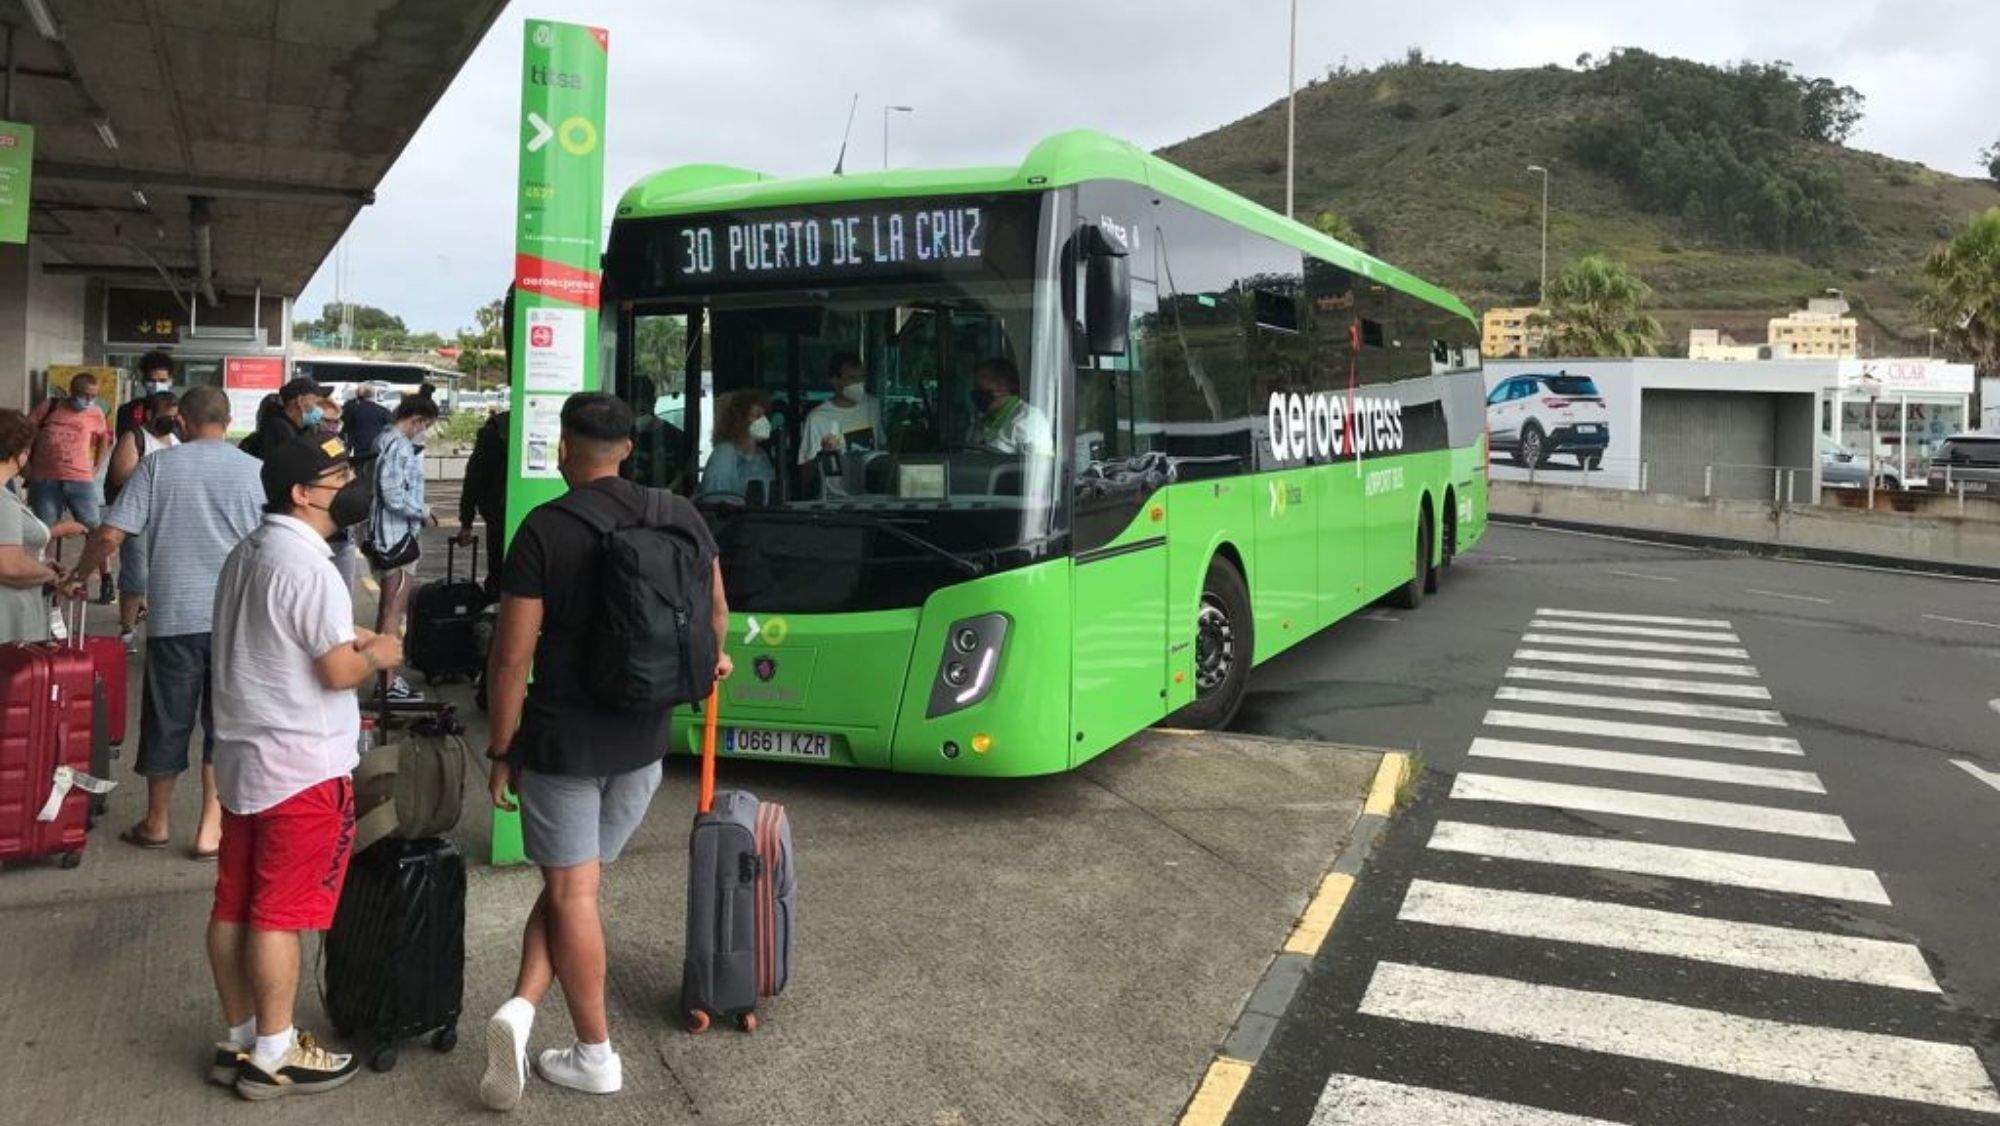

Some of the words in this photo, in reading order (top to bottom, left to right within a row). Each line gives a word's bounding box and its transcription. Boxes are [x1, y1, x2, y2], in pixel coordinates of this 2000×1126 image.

[680, 226, 714, 274] 30
[728, 219, 821, 272] PUERTO
[831, 216, 862, 265] DE
[872, 213, 904, 263] LA
[915, 208, 982, 261] CRUZ
[1268, 390, 1404, 478] aeroexpress
[738, 730, 783, 752] 0661
[790, 732, 826, 756] KZR
